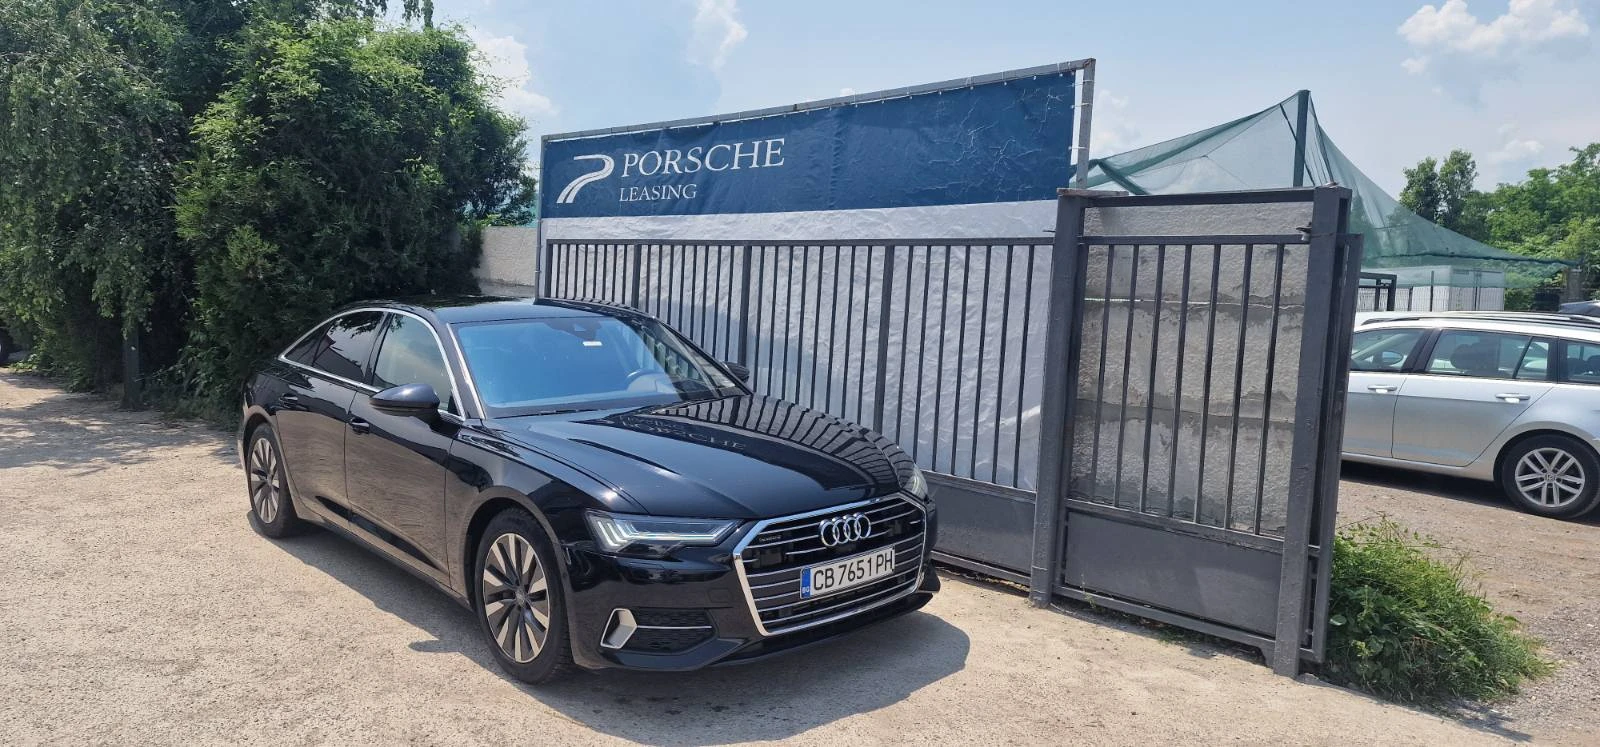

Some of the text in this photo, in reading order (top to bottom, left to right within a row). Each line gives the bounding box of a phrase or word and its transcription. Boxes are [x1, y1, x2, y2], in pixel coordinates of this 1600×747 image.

[621, 137, 786, 178] PORSCHE
[619, 183, 698, 203] LEASING
[813, 550, 893, 591] CB 7651 PH
